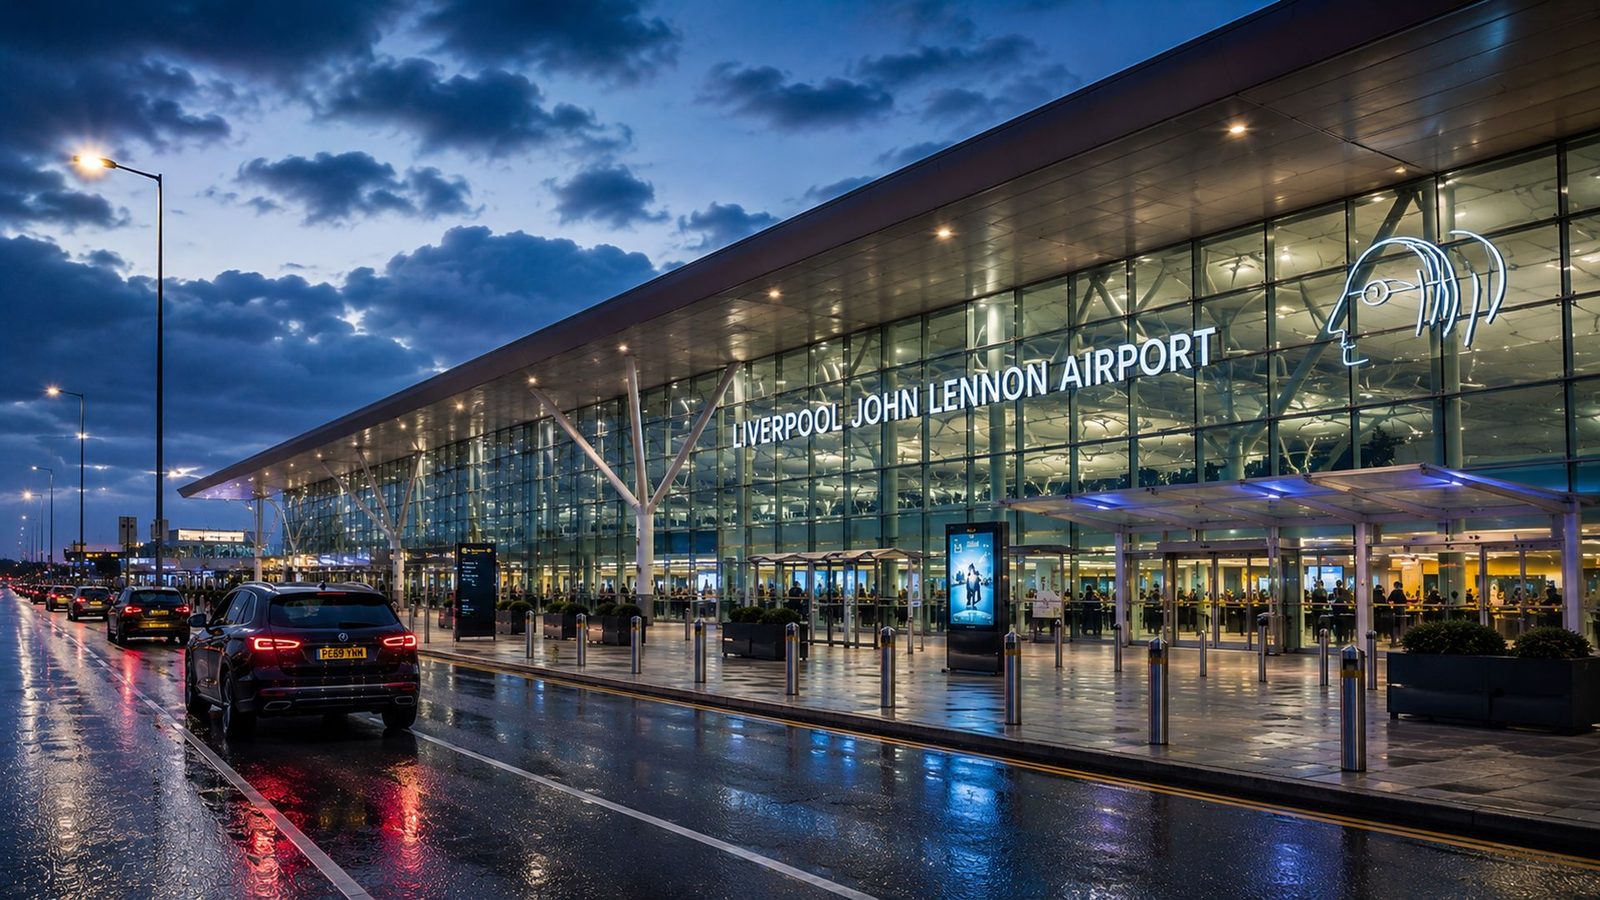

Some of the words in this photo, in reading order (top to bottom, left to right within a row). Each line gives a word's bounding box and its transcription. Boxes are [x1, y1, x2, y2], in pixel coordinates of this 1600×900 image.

[733, 403, 842, 448] LIVERPOOL
[851, 386, 919, 428] JOHN
[929, 360, 1048, 414] LENNON
[1060, 326, 1217, 391] AIRPORT
